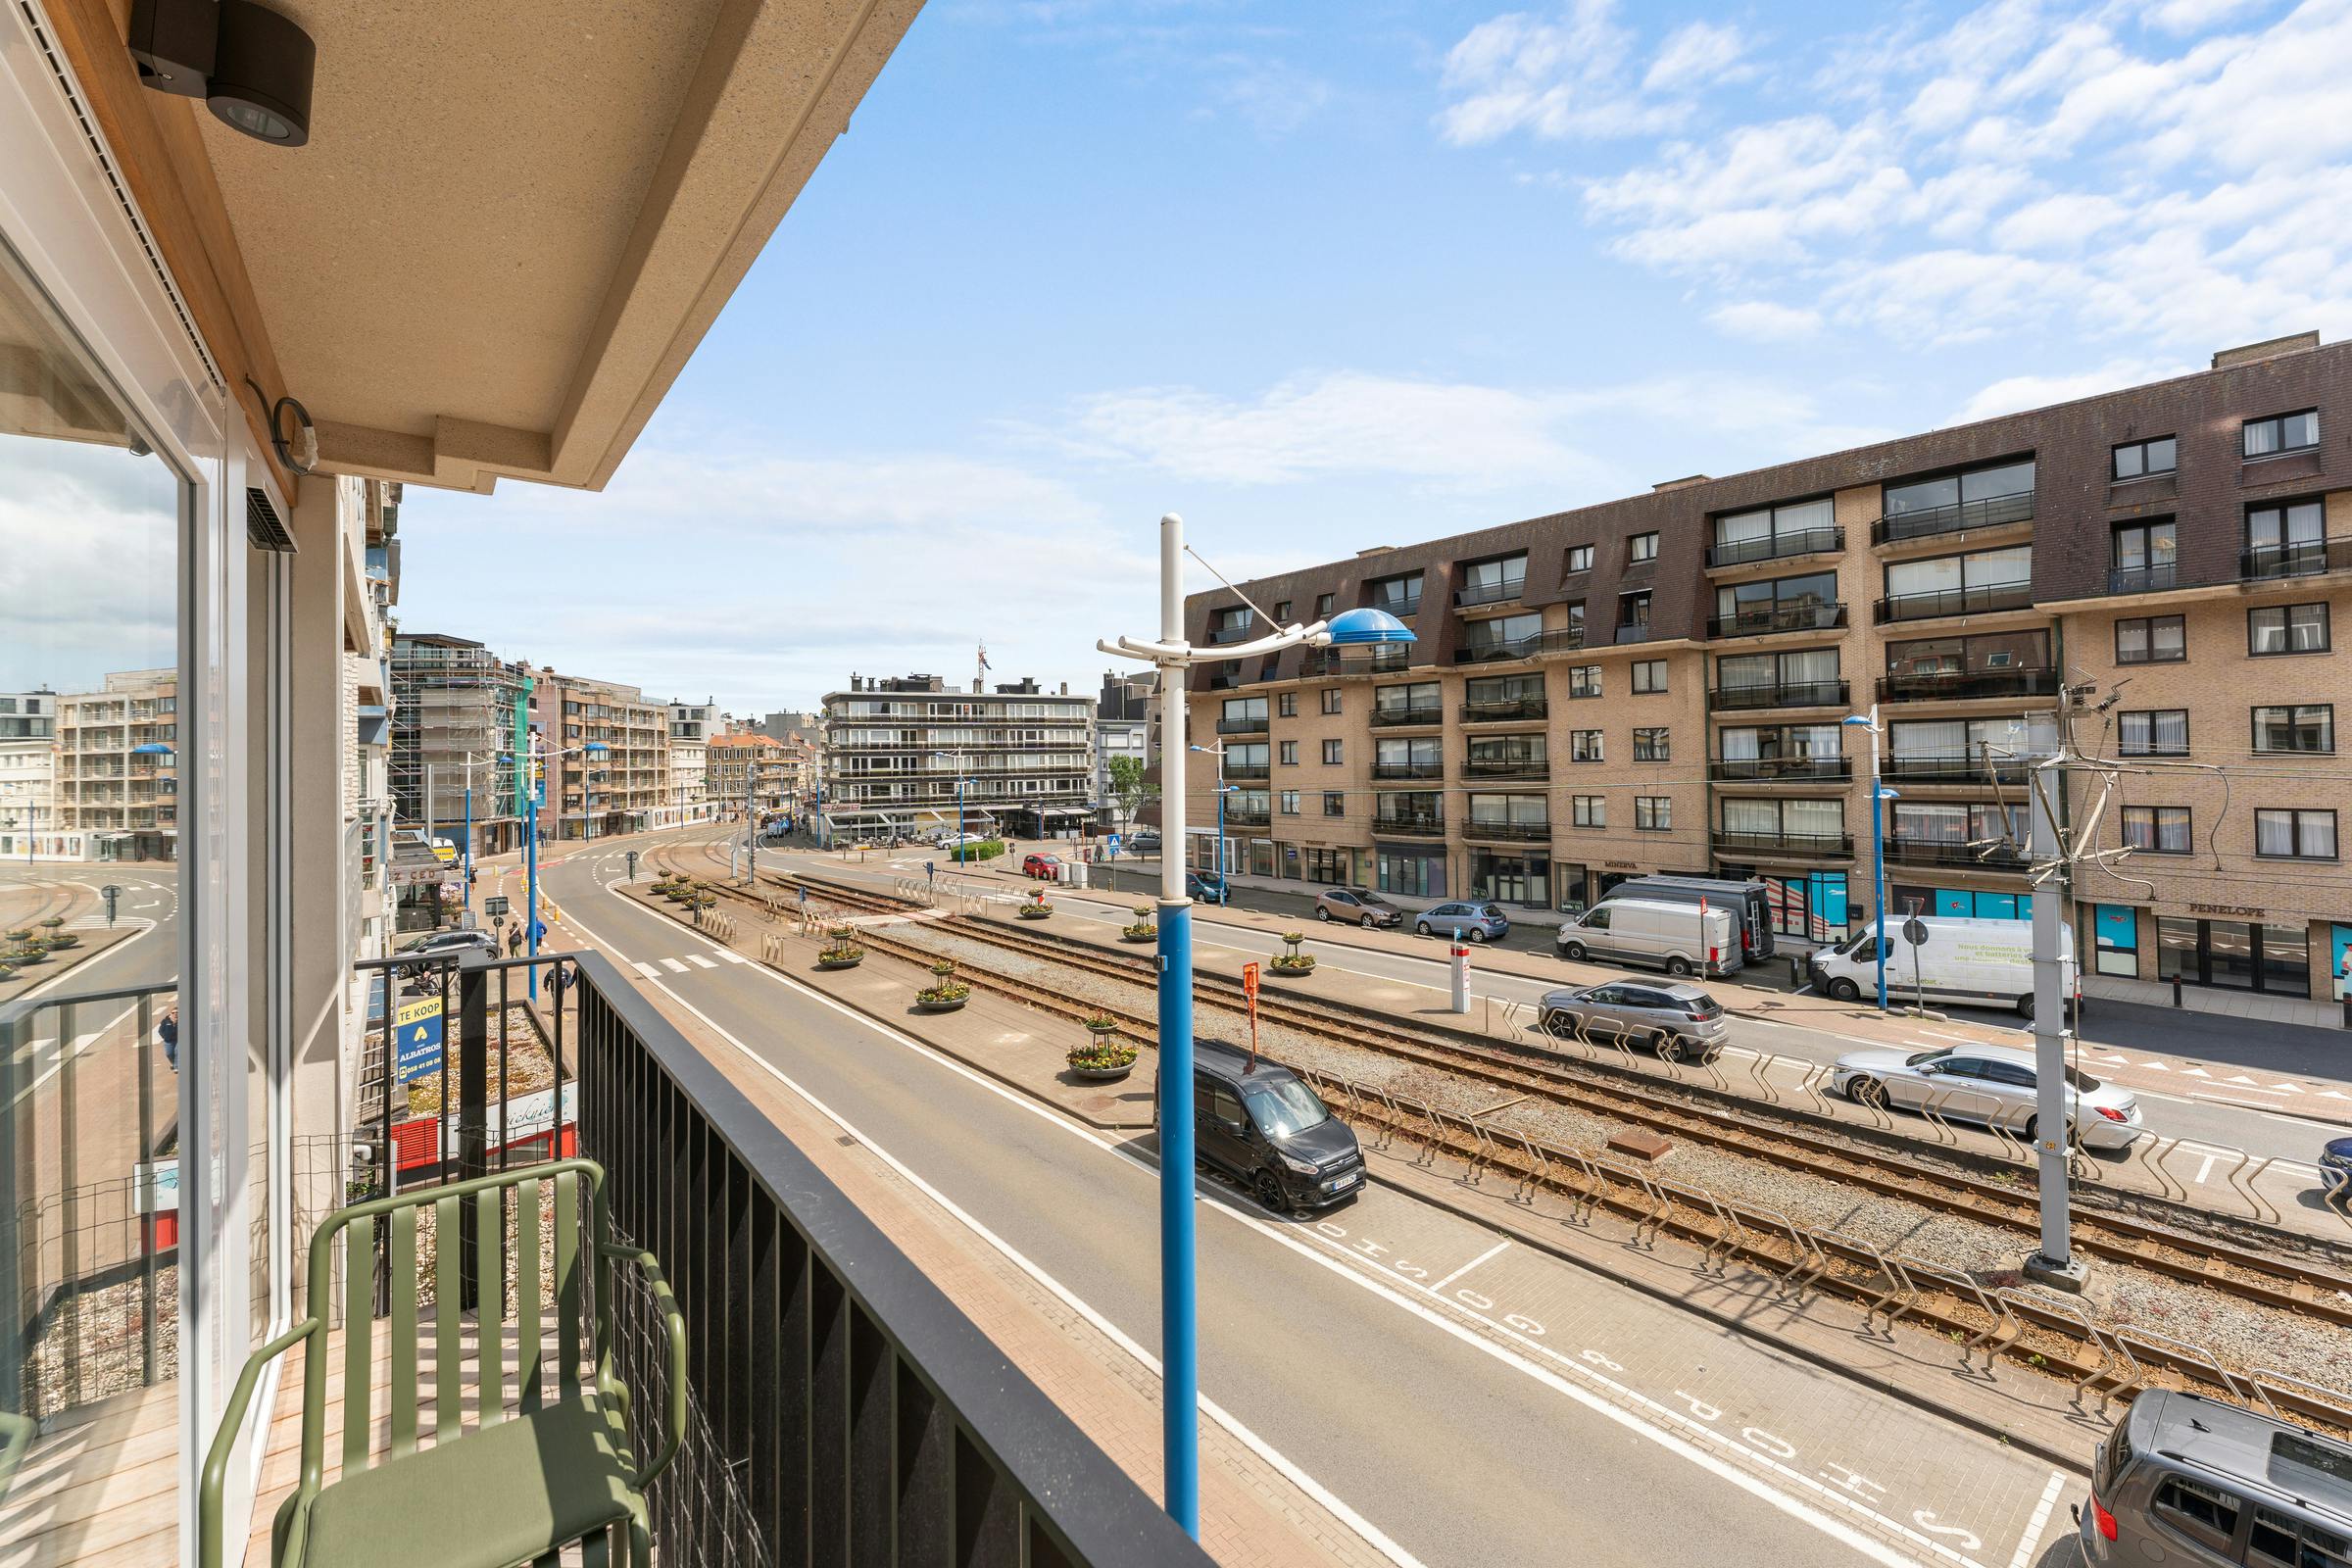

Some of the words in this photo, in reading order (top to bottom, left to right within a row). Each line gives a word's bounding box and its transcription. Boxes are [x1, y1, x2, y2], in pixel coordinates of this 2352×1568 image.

[2188, 903, 2266, 917] PENELOPE
[1980, 944, 2016, 953] donnons
[399, 1010, 411, 1021] TE
[414, 1003, 440, 1018] KOOP
[399, 1042, 441, 1063] ALBATROS
[1455, 1288, 1547, 1337] GO
[1673, 1389, 1982, 1551] SHOP
